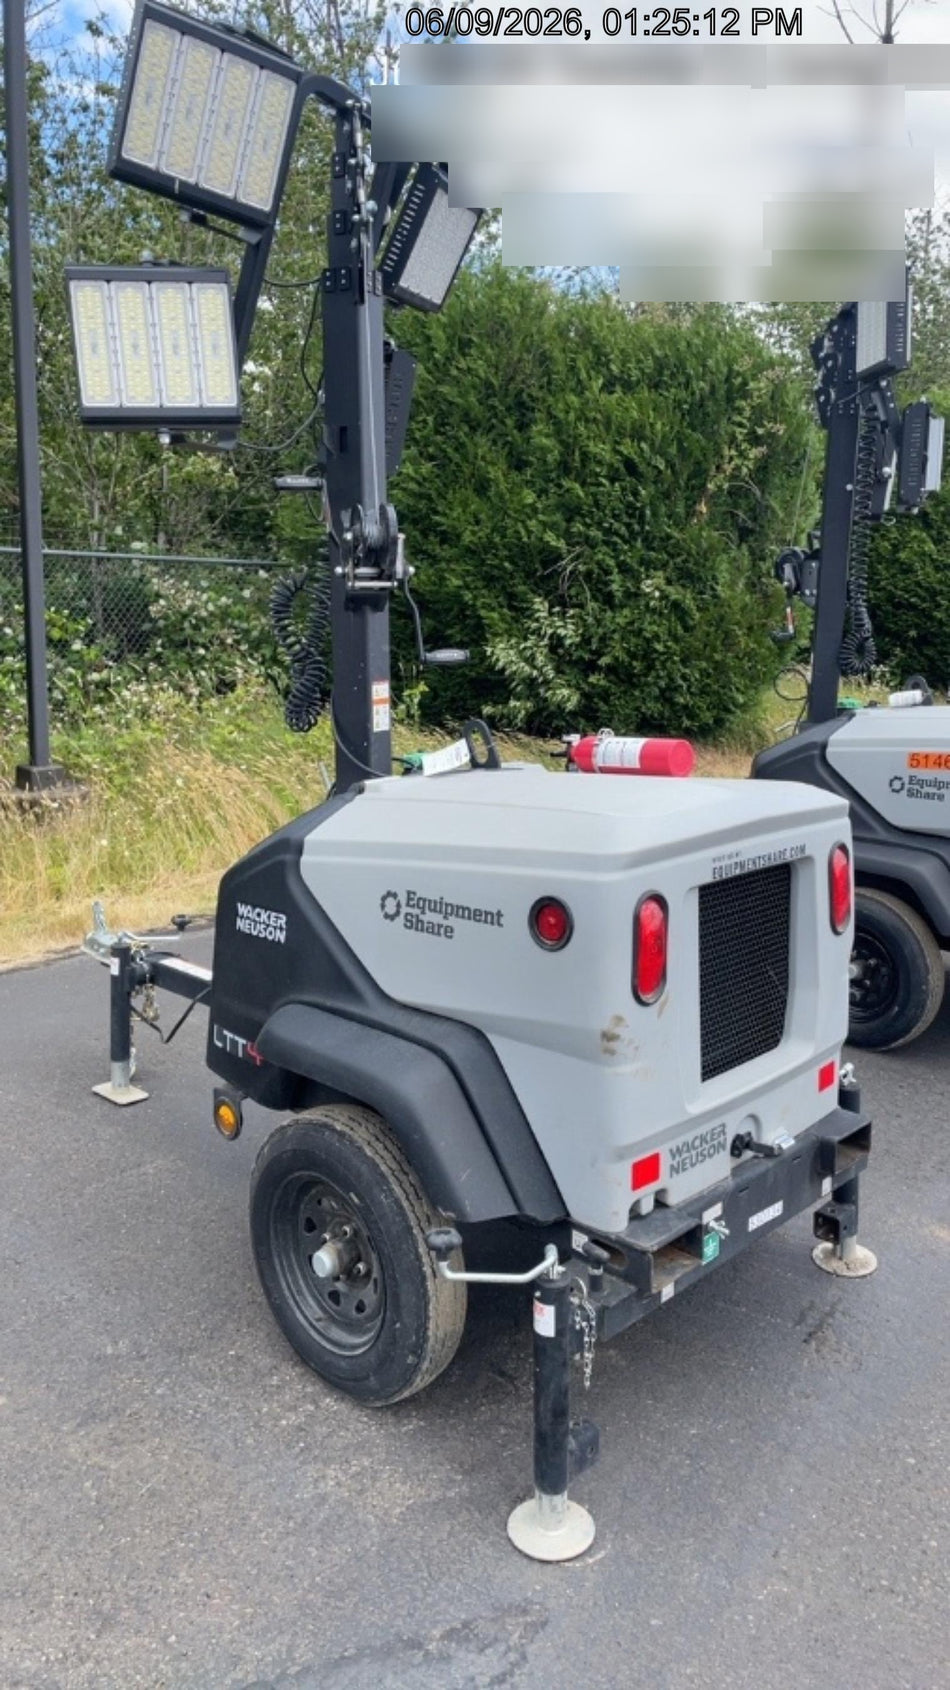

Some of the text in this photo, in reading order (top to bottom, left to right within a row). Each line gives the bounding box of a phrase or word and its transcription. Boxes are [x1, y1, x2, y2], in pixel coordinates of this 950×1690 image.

[906, 787, 945, 802] Share
[712, 844, 806, 879] EQUIPMENTSHARE.COM
[236, 902, 287, 928] WACKER
[403, 911, 455, 939] Share
[405, 890, 504, 927] Equipment
[236, 918, 286, 944] NEUSON
[213, 1024, 264, 1066] LTT4
[669, 1123, 727, 1161] WACKER
[669, 1138, 727, 1179] NEUSON
